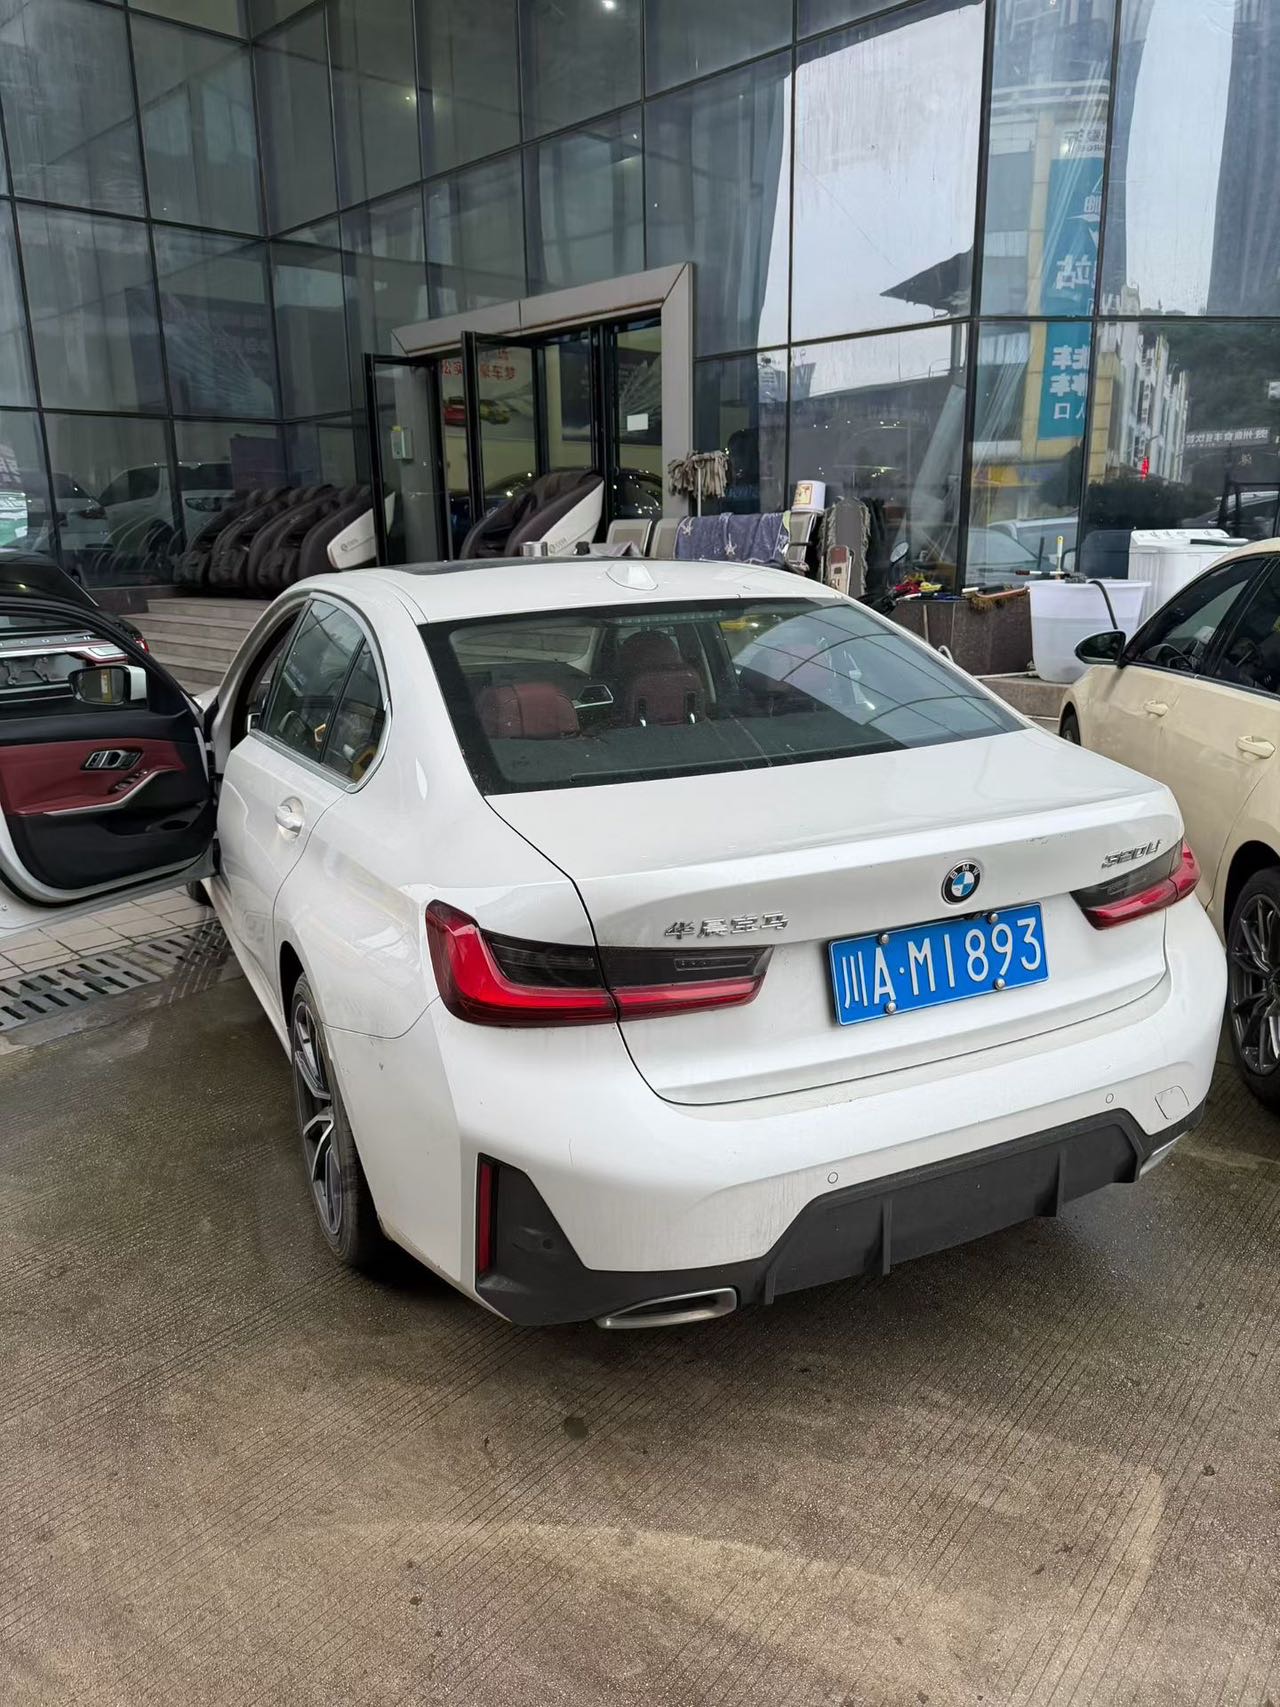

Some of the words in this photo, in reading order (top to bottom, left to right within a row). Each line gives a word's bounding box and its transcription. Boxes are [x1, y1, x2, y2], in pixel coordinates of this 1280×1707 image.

[949, 863, 980, 880] BMW
[664, 911, 789, 939] 华晨宝马
